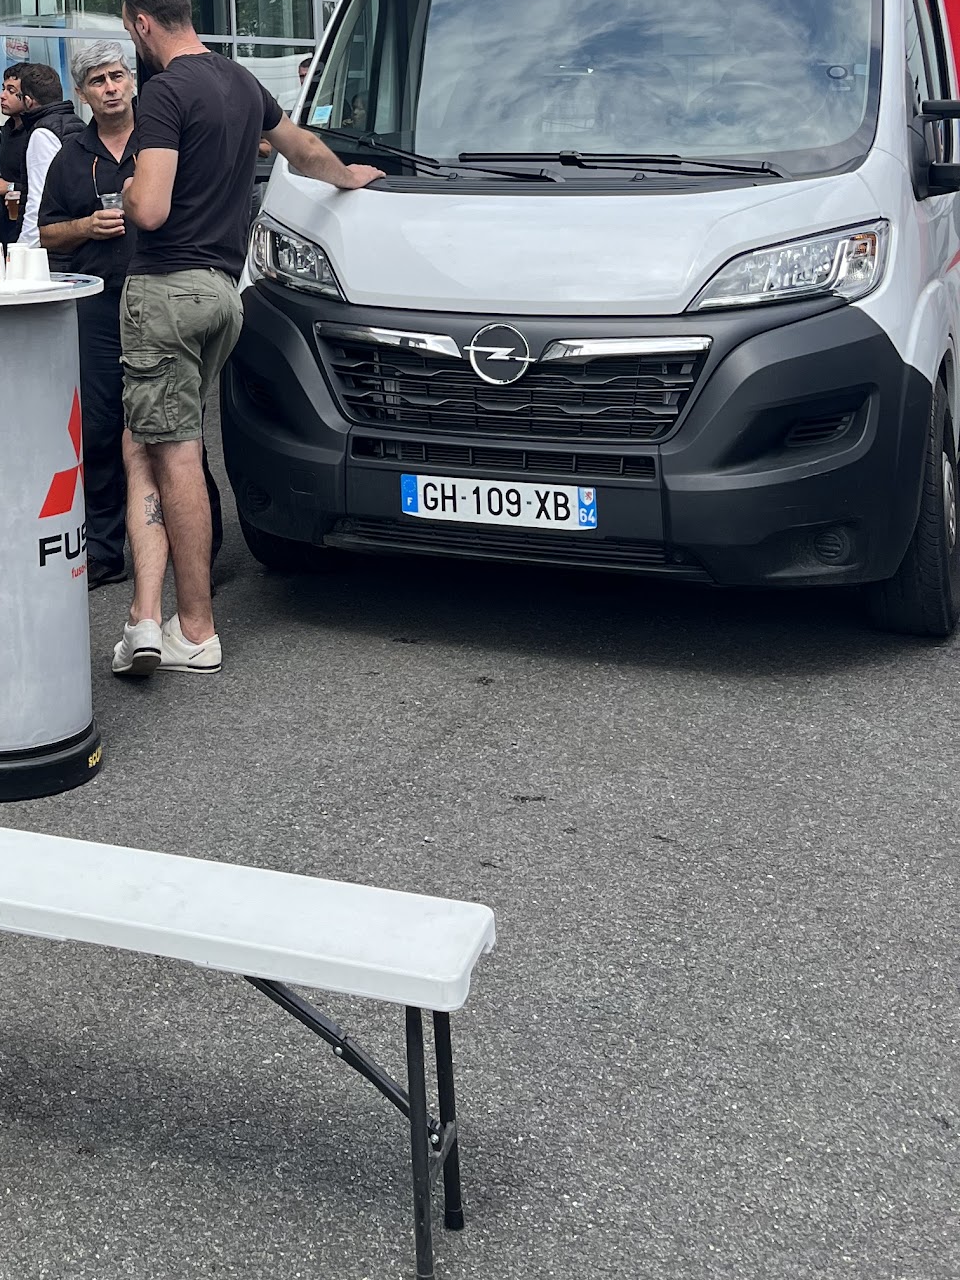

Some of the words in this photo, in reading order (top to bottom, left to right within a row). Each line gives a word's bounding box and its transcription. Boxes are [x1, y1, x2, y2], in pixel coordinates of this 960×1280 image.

[407, 496, 414, 507] F
[423, 482, 571, 521] GH-109-XB
[579, 507, 596, 524] 64
